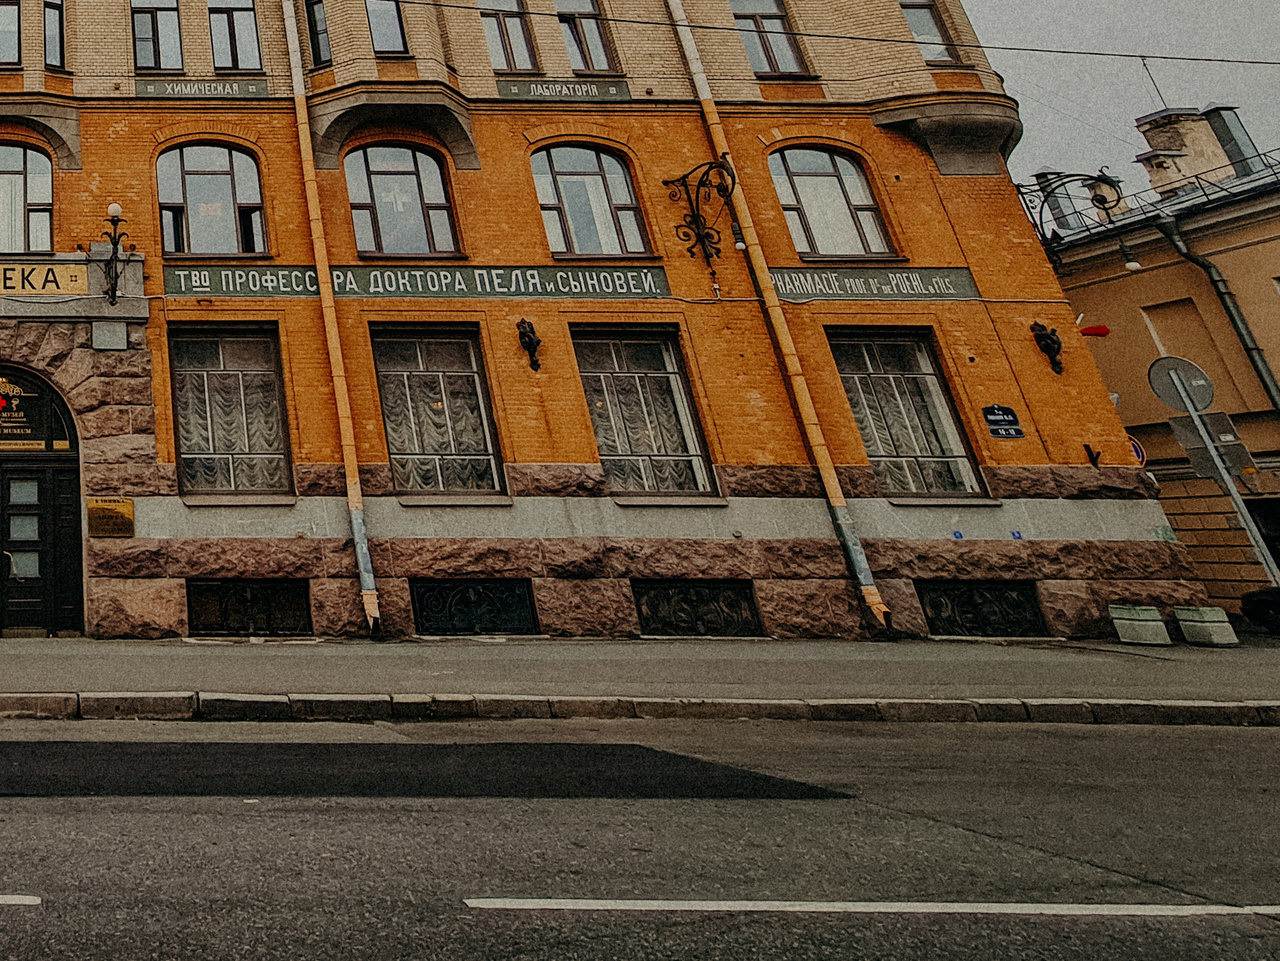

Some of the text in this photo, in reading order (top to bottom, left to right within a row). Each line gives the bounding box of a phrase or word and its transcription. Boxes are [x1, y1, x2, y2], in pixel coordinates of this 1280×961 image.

[164, 82, 239, 95] ХИМИЧЕСКАЯ
[530, 82, 599, 97] ЛАБОРАТОРІЯ
[220, 270, 359, 293] ПРОФЕССРА
[369, 270, 468, 293] ДОКТОРА
[473, 269, 543, 292] ПЕЛЯ
[556, 268, 661, 293] СЫНОВЕЙ.
